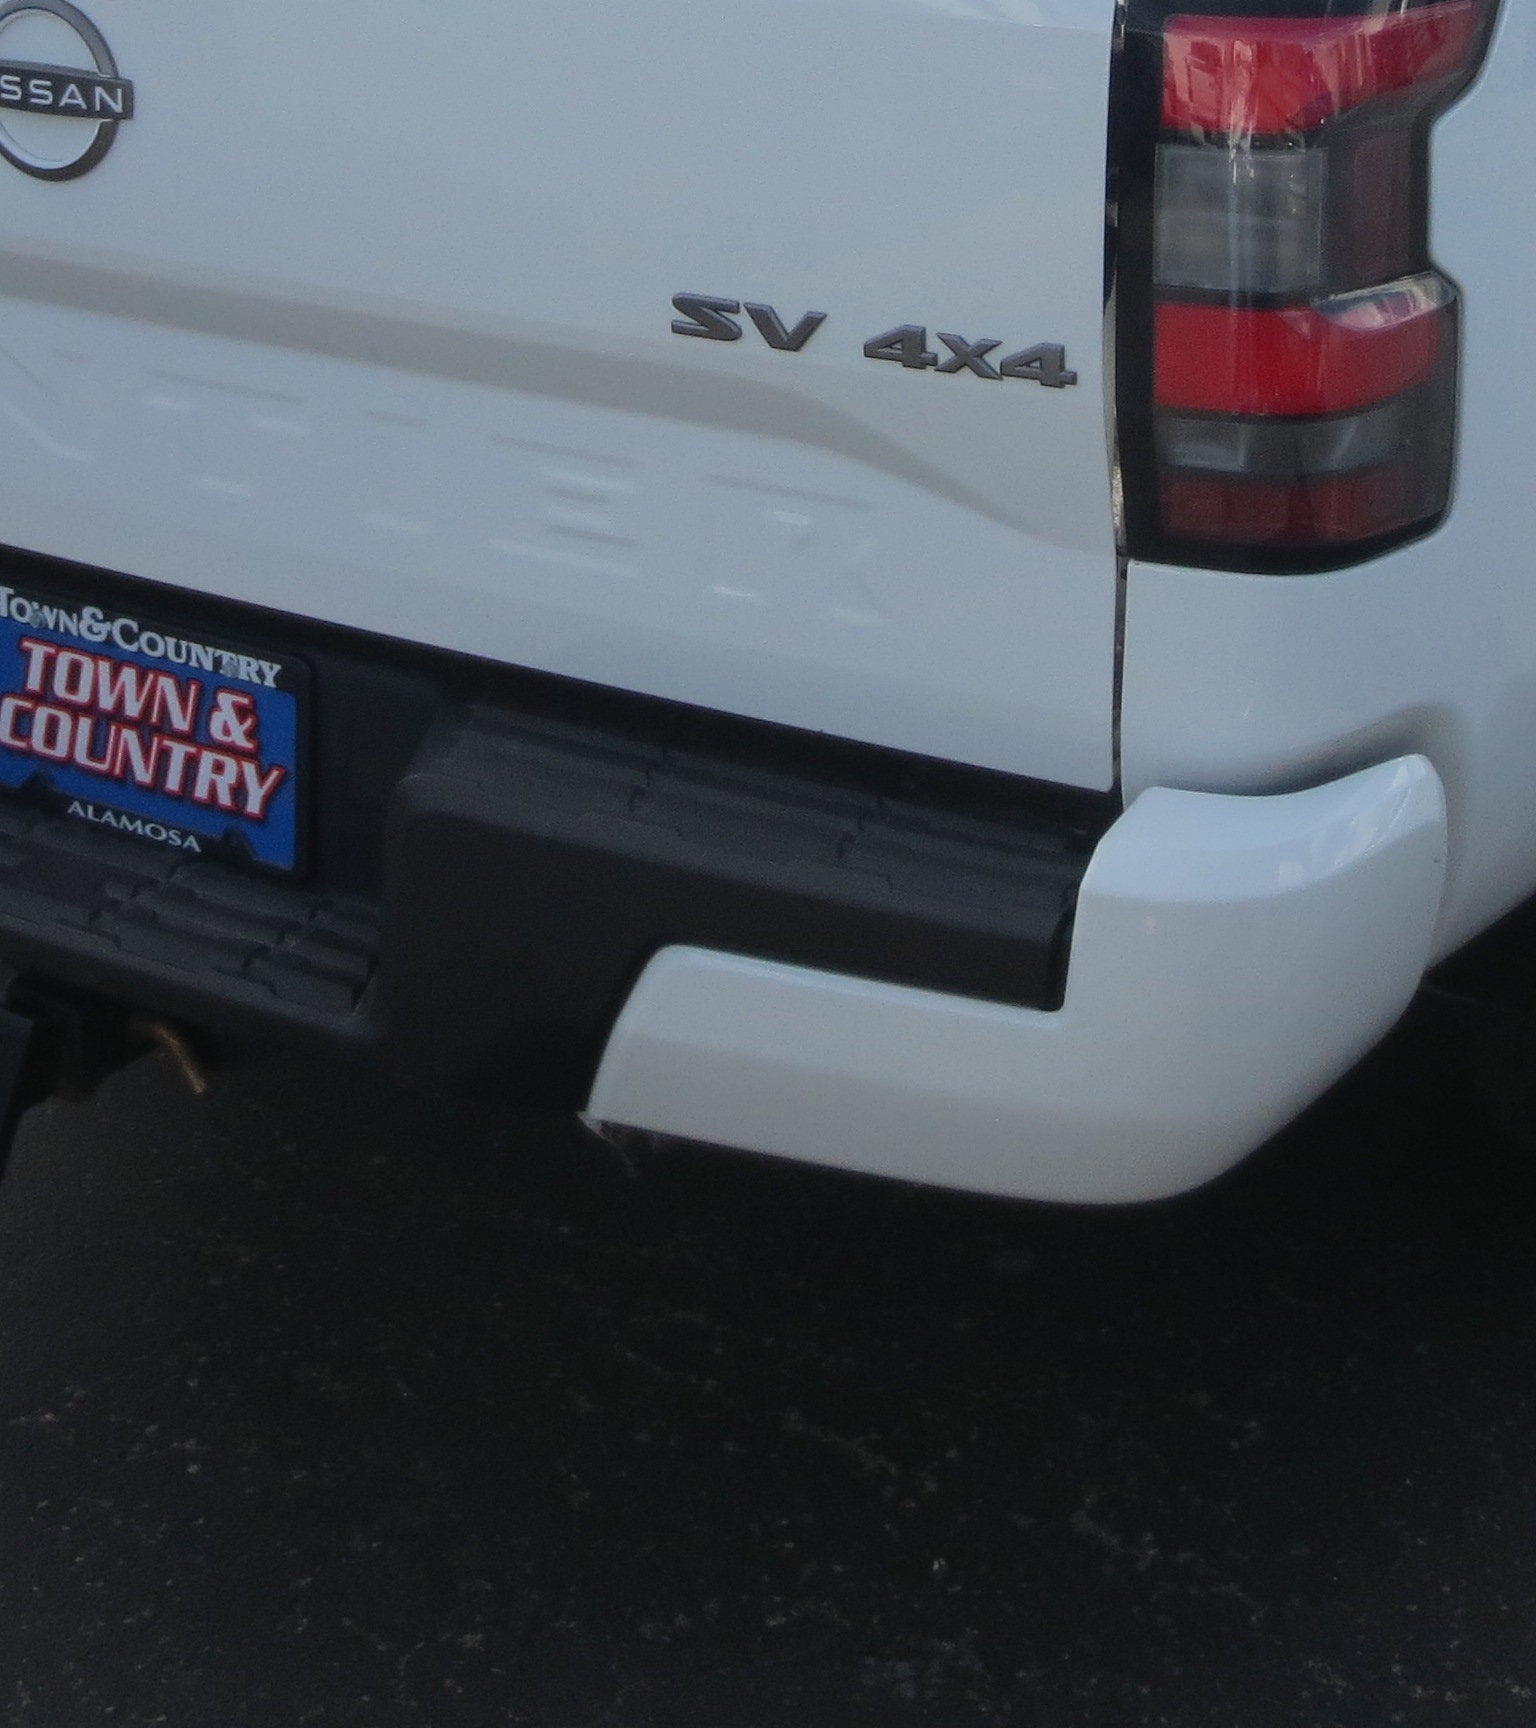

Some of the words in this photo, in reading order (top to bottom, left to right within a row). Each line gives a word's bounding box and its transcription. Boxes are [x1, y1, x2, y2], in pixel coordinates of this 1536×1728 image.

[671, 291, 828, 353] SV
[18, 635, 202, 735] TOWN
[207, 686, 259, 752] &
[67, 800, 202, 854] ALAMOSA
